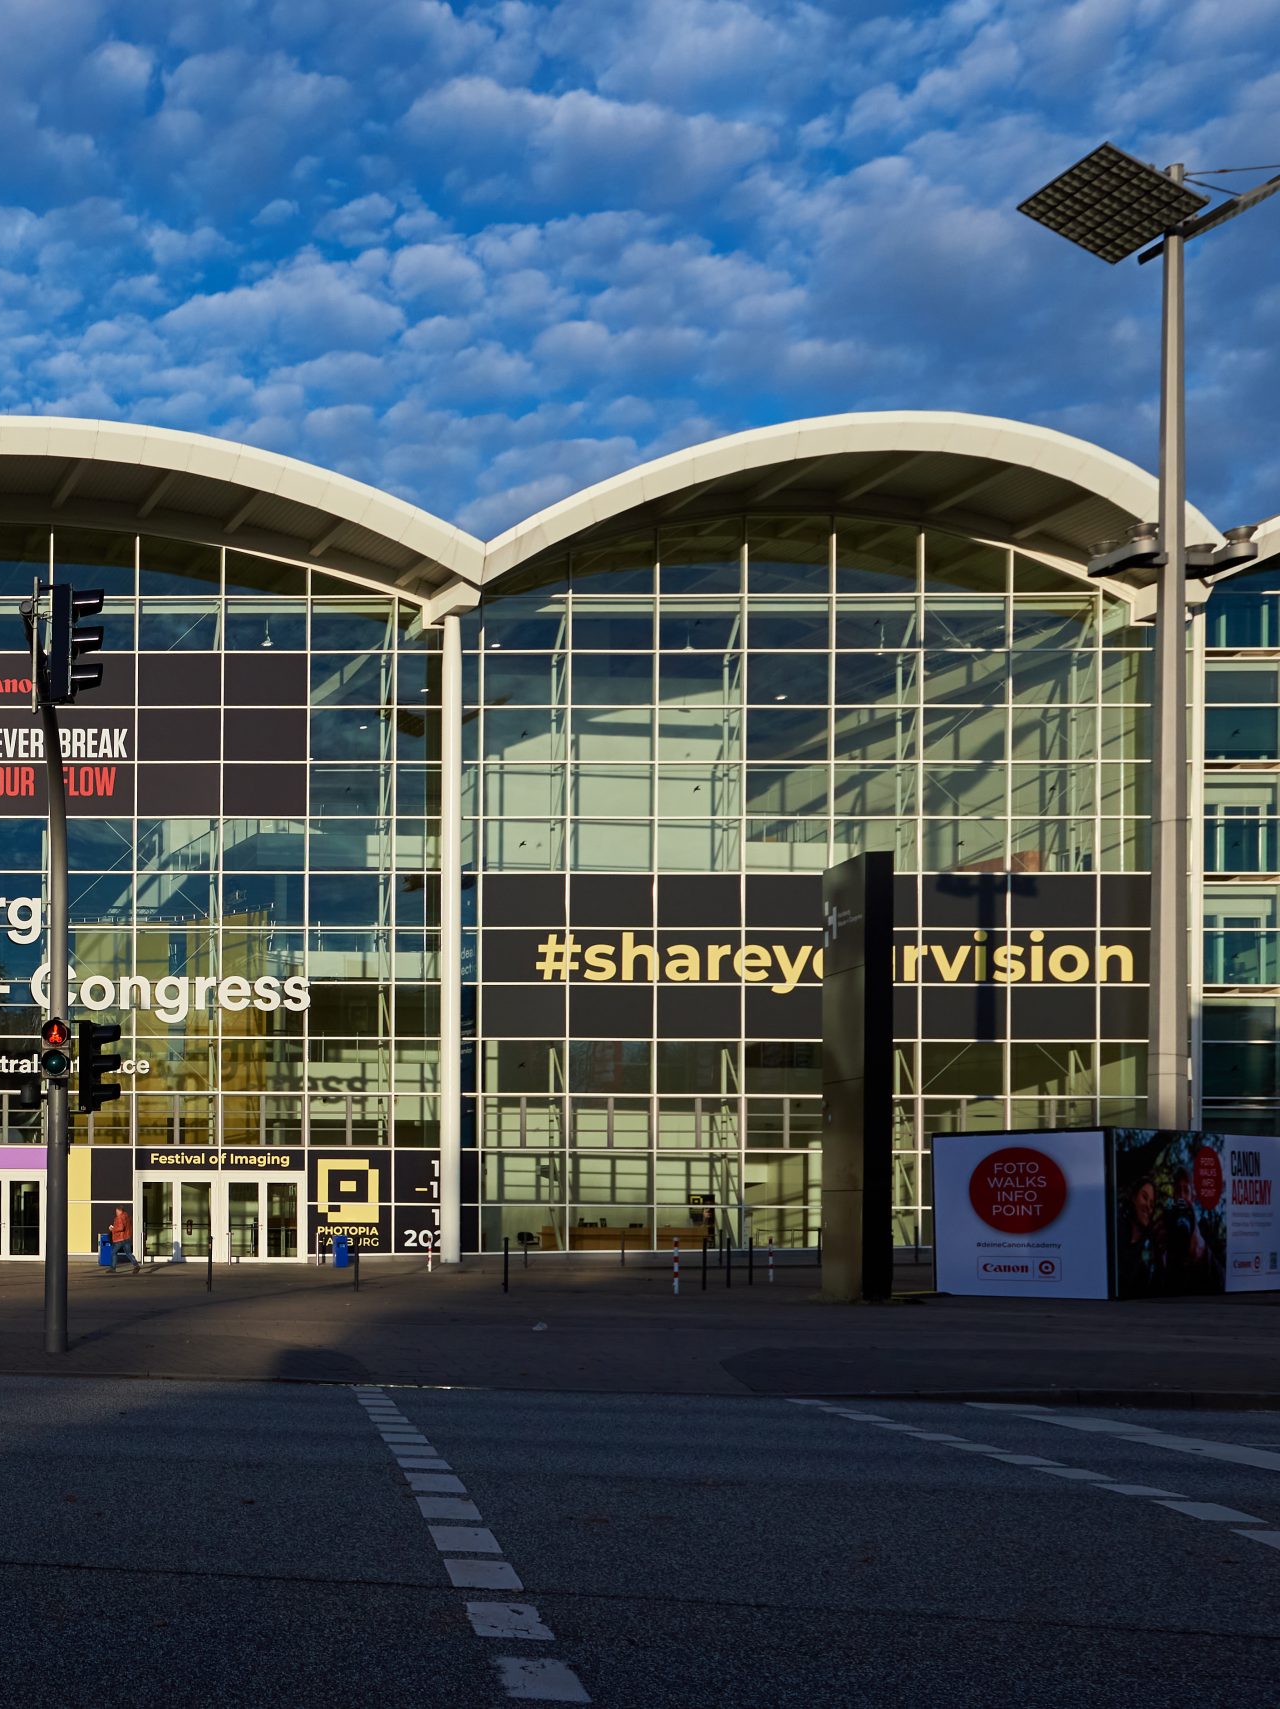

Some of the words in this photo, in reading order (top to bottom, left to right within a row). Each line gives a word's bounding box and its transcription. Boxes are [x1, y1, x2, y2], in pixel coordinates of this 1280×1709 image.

[58, 728, 128, 758] BREAK
[535, 930, 1134, 994] #shareyrvision
[30, 961, 311, 1024] Congress
[150, 1152, 205, 1165] Festival
[209, 1152, 227, 1165] of
[230, 1152, 290, 1168] Imaging
[1231, 1151, 1261, 1177] CANON
[993, 1162, 1040, 1174] FOTO
[987, 1176, 1047, 1189] WALKS
[997, 1190, 1038, 1202] INFO
[1231, 1180, 1273, 1205] ACADEMY
[992, 1204, 1044, 1217] POINT
[317, 1226, 379, 1236] PHOTOPIA
[982, 1263, 1029, 1273] Canon
